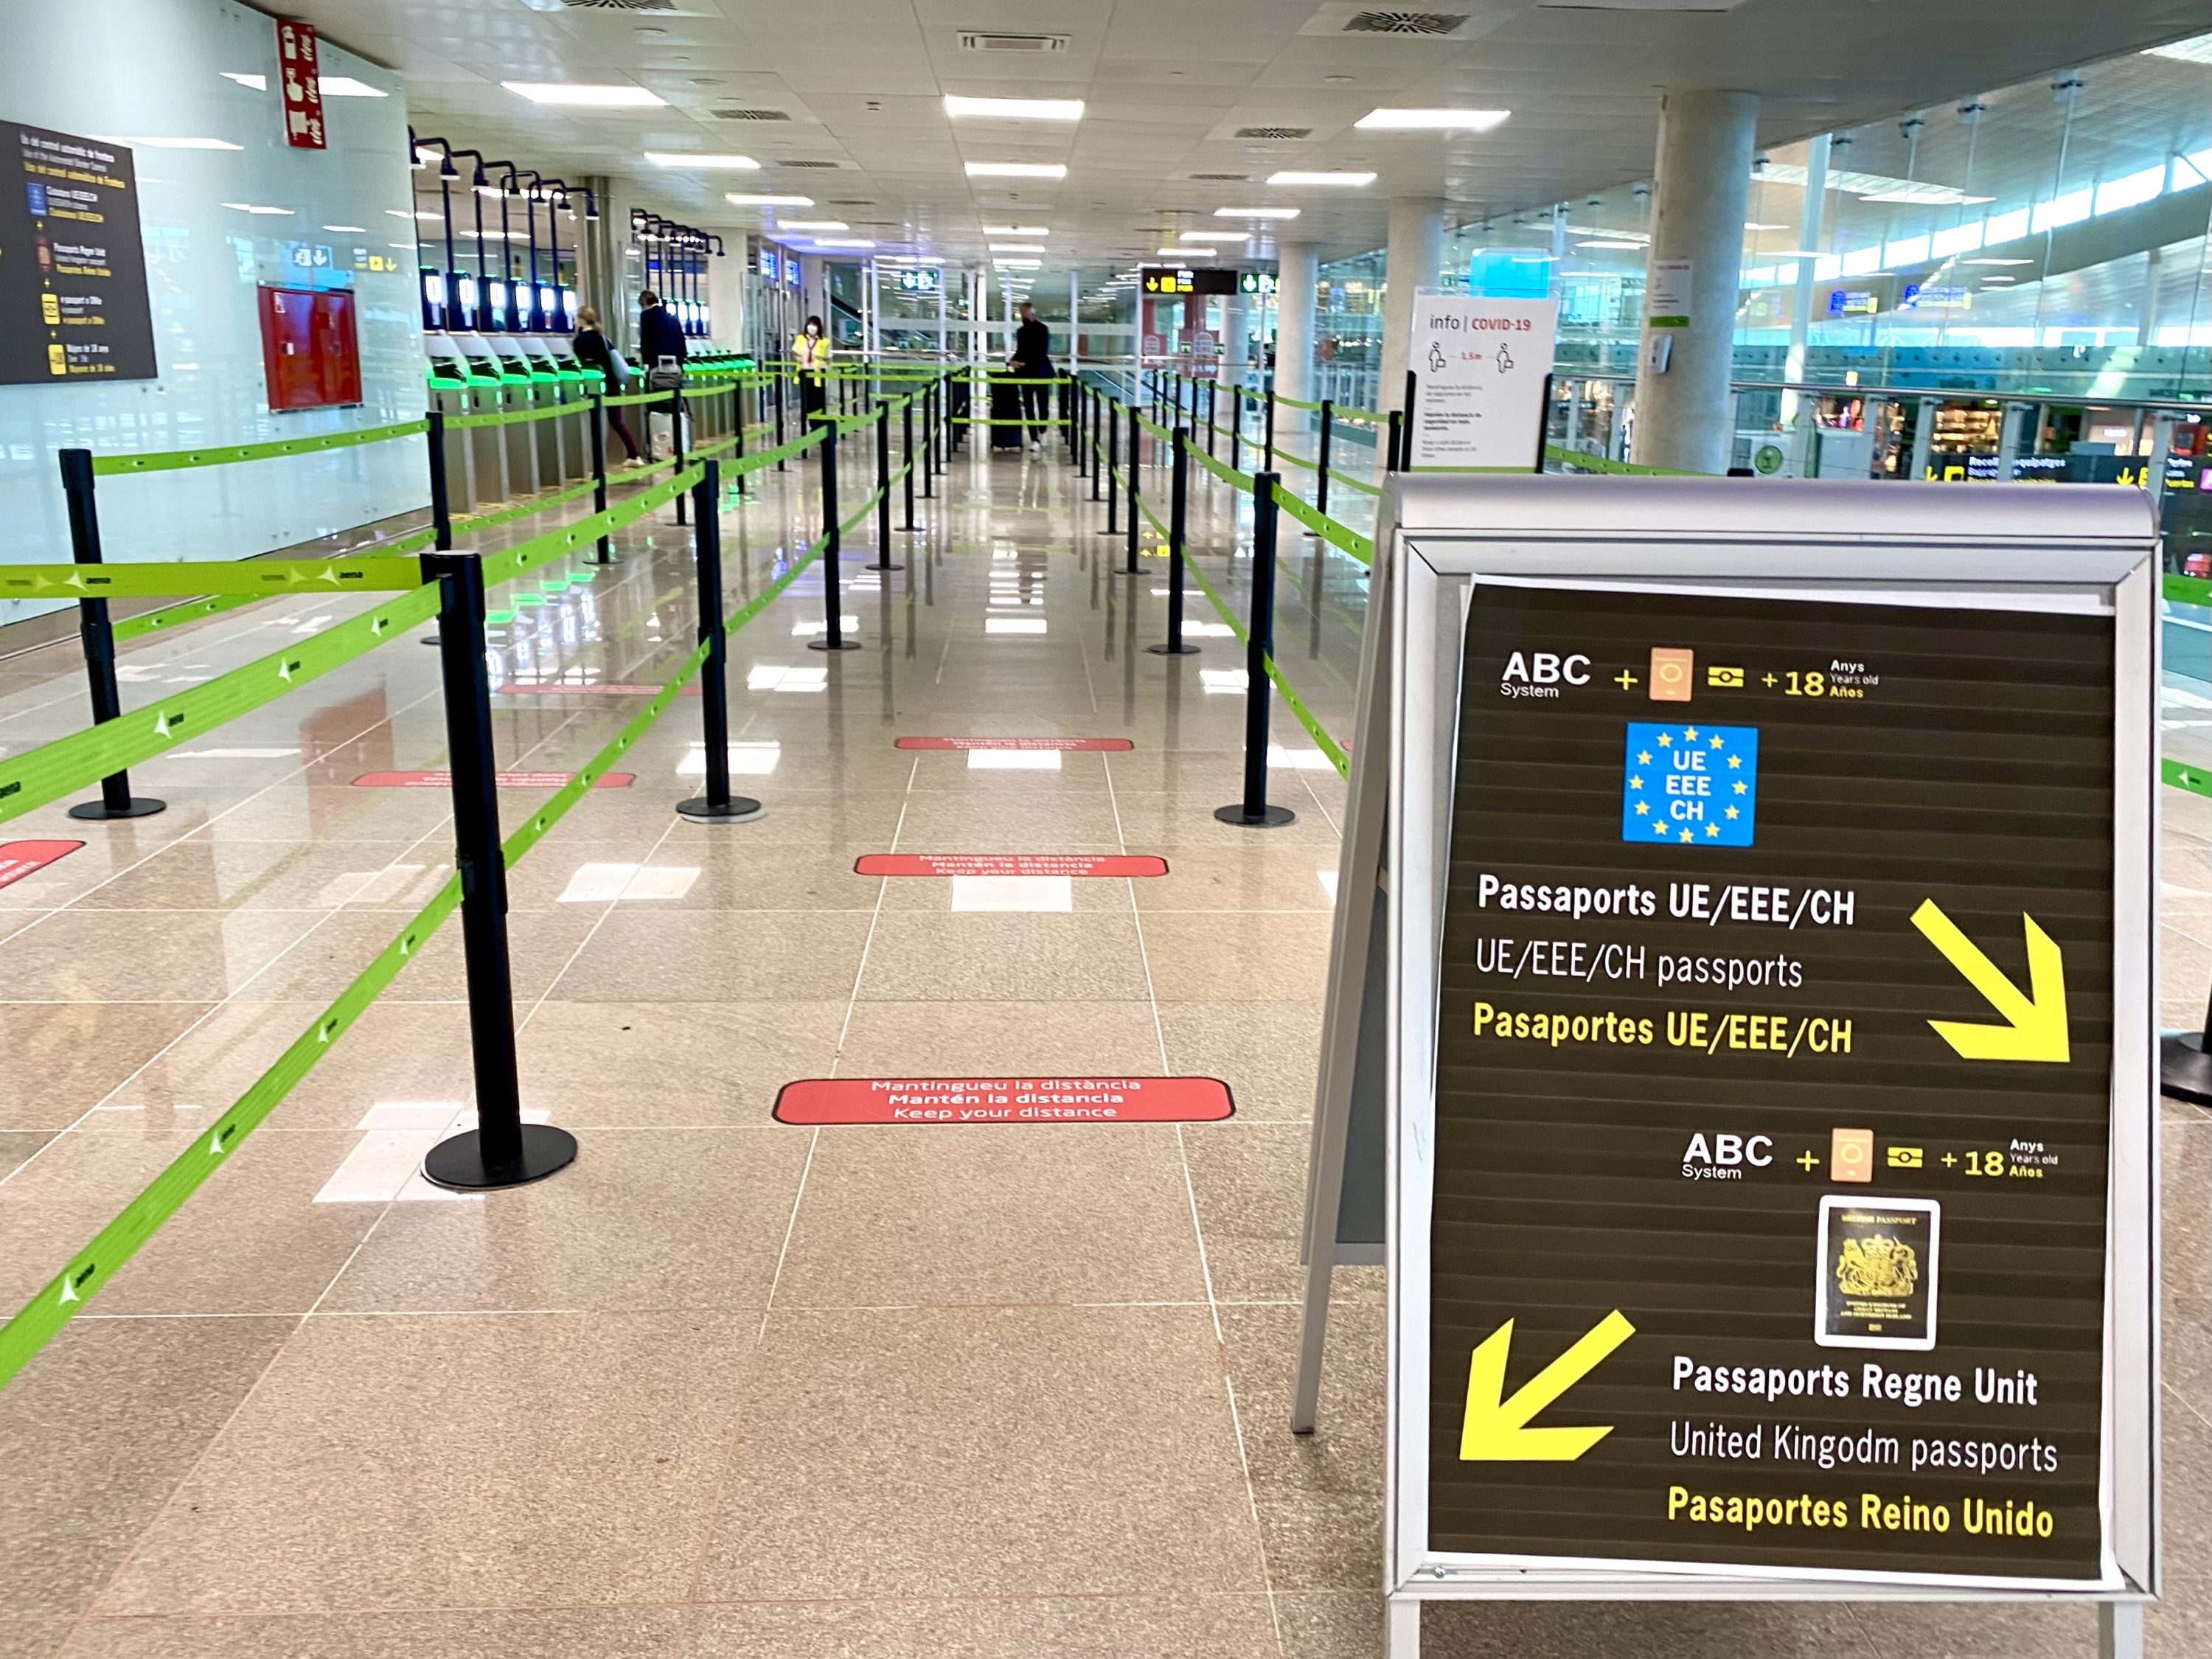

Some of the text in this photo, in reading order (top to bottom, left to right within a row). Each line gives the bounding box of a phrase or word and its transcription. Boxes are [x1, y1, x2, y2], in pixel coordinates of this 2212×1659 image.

[1430, 315, 1531, 331] info COVID-19
[1502, 651, 1591, 685] ABC
[1830, 659, 1865, 674] Anys
[1829, 672, 1879, 686] Years old
[1500, 683, 1559, 698] System
[1829, 686, 1864, 698] Años
[1673, 750, 1707, 771] UE
[1665, 774, 1711, 796] EEE
[1669, 799, 1704, 821] CH
[1478, 874, 1854, 930] Passaports UE/EEE/CH
[1476, 938, 1803, 991] UE/EEE/CH passports
[1474, 1002, 1852, 1058] Pasaportes UE/EEE/CH
[872, 1079, 1141, 1093] Mantingueu la distància
[888, 1093, 1124, 1105] Mantén la distancia
[894, 1107, 1117, 1121] Keep your distance
[1683, 1133, 1773, 1166] ABC
[2010, 1138, 2044, 1154] Anys
[2009, 1152, 2058, 1165] Years old
[1681, 1164, 1742, 1180] System
[2009, 1165, 2043, 1178] Años
[1673, 1356, 2038, 1407] Passaports Regne Unit
[1671, 1421, 2058, 1475] United Kingodm passports
[1668, 1486, 2053, 1537] Pasaportes Reino Unido
